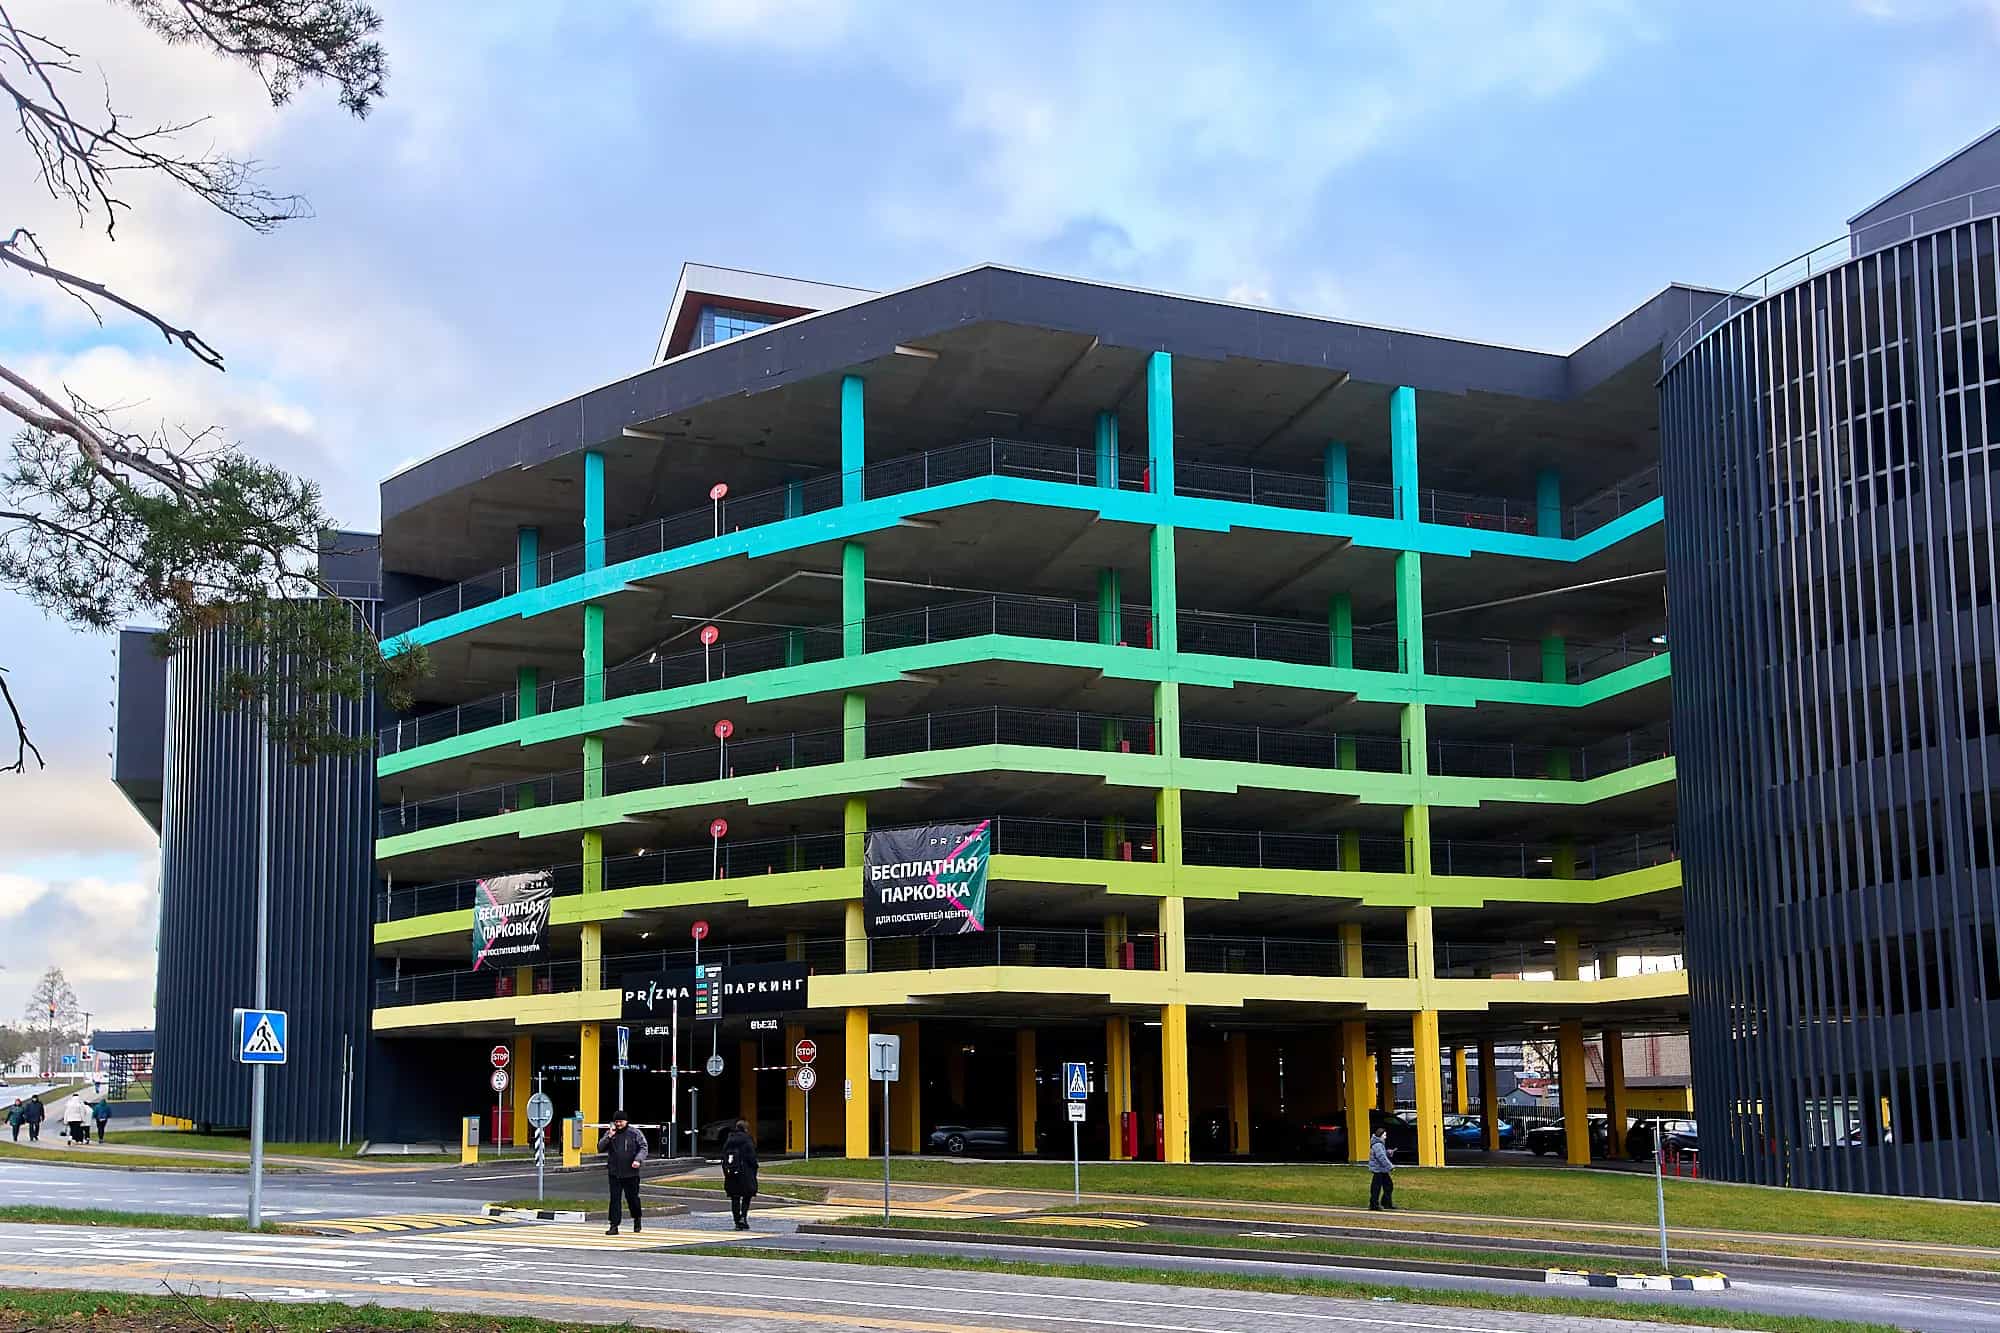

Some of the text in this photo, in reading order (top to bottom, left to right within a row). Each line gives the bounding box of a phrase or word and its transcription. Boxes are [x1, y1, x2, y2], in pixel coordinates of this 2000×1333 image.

[871, 856, 979, 881] БЕСПЛАТНАЯ
[881, 881, 971, 904] ПАРКОВКА
[479, 899, 545, 921] БЕСПЛАТНАЯ
[875, 914, 891, 926] ДЛЯ
[891, 909, 944, 923] ПОСЕТИТЕЛЕЙ
[482, 920, 538, 941] ПАРКОВКА
[724, 979, 805, 996] ПАРКИНГ
[750, 1019, 778, 1031] ВЪЕЗД
[491, 1053, 508, 1061] STOP
[796, 1047, 816, 1057] STOP
